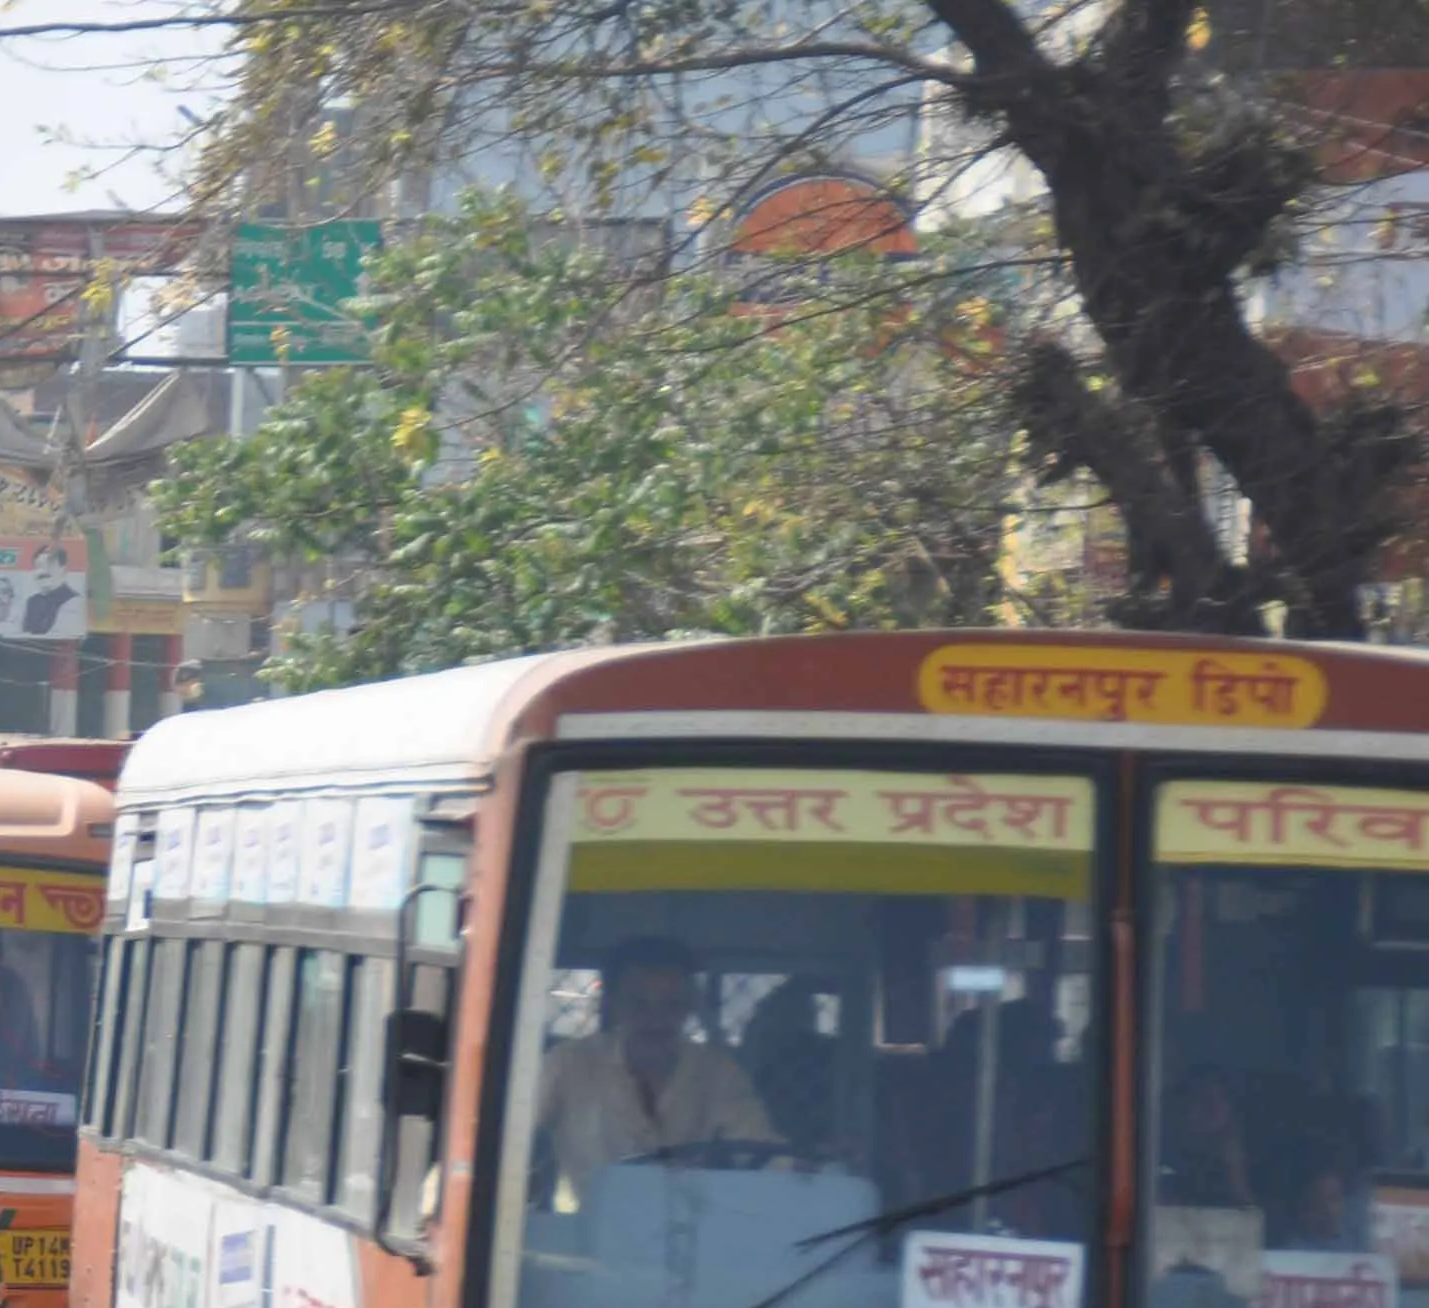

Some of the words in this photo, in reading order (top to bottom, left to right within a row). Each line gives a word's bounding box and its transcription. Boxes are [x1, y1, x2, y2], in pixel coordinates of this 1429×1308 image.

[940, 664, 1166, 721] सहारनपुर
[1191, 659, 1299, 716] डिपो
[678, 786, 848, 833] उत्तर
[876, 774, 1077, 840] प्रदेश
